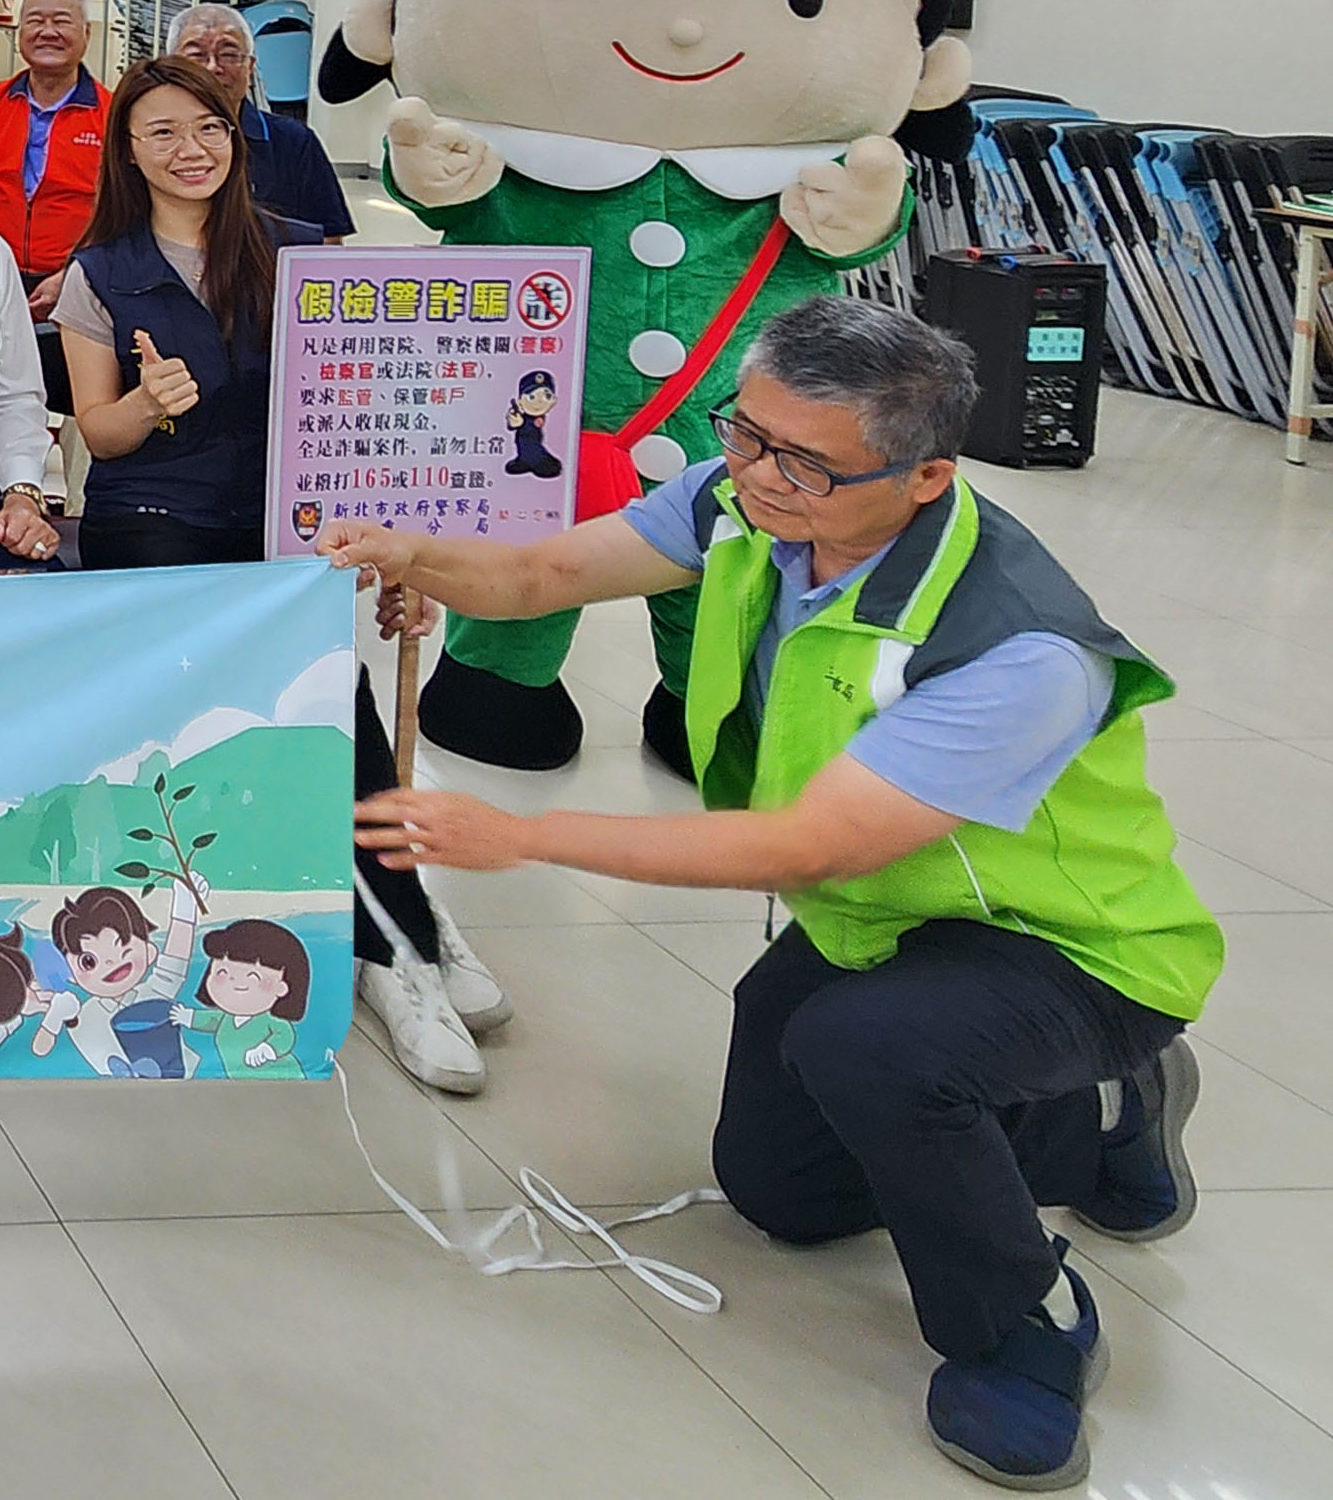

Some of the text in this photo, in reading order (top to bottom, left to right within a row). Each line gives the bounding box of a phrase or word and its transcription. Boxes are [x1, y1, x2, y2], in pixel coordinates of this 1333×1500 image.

[297, 279, 512, 324] 假檢警詐騙
[334, 499, 490, 519] 新北市政府警察局
